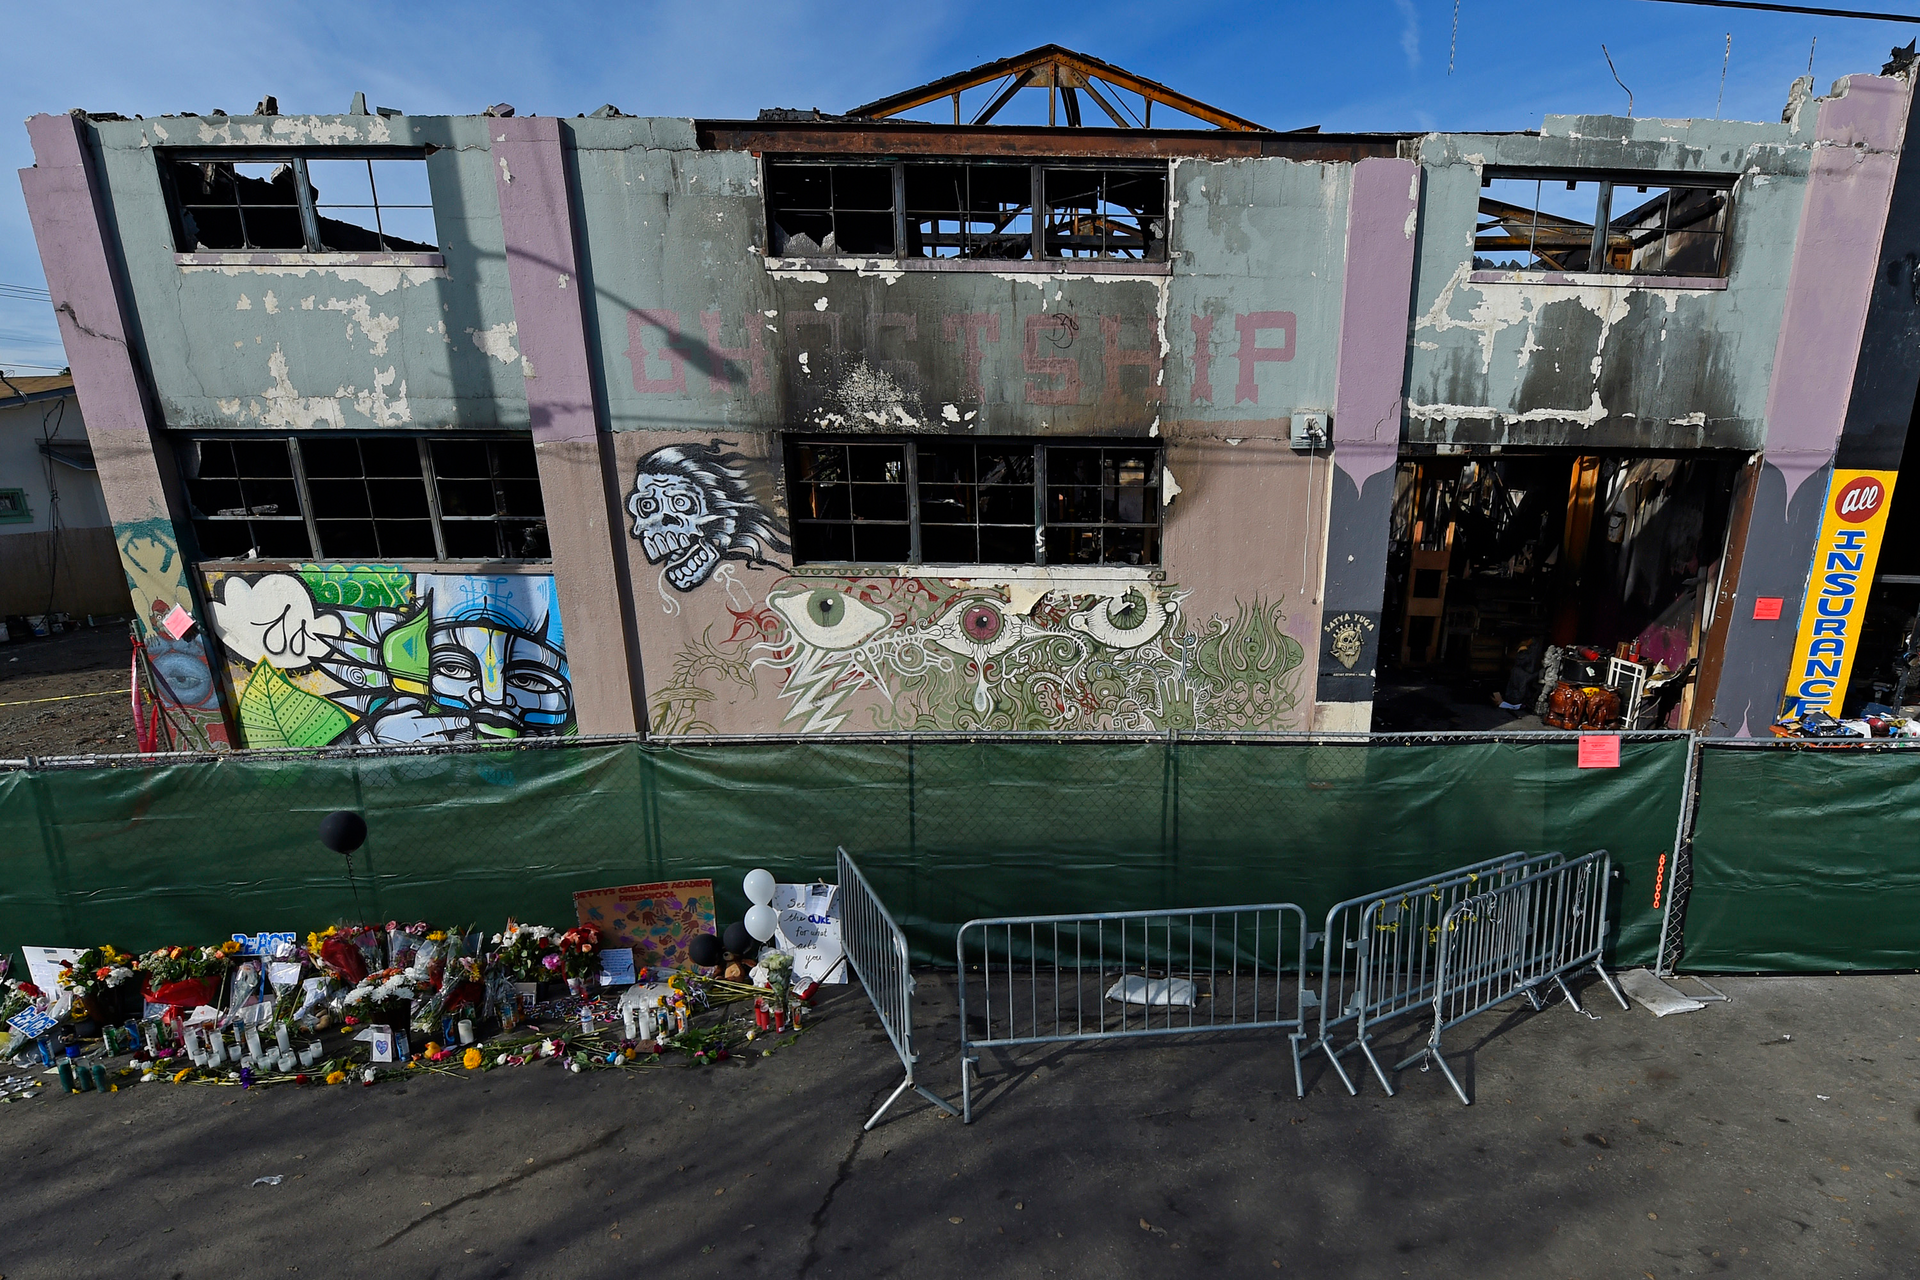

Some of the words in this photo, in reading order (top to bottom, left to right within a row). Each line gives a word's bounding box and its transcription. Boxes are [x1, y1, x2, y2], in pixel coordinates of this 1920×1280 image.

[1842, 485, 1878, 516] all
[1323, 612, 1351, 633] SATYA
[1353, 613, 1375, 632] YUGA
[1795, 530, 1867, 720] INSURANCE
[671, 880, 712, 889] ACADEMY
[618, 890, 676, 902] PRESCHOOL
[783, 912, 806, 922] the
[795, 927, 810, 938] for
[810, 927, 828, 937] what
[805, 954, 823, 969] you
[8, 1006, 57, 1038] PEACE
